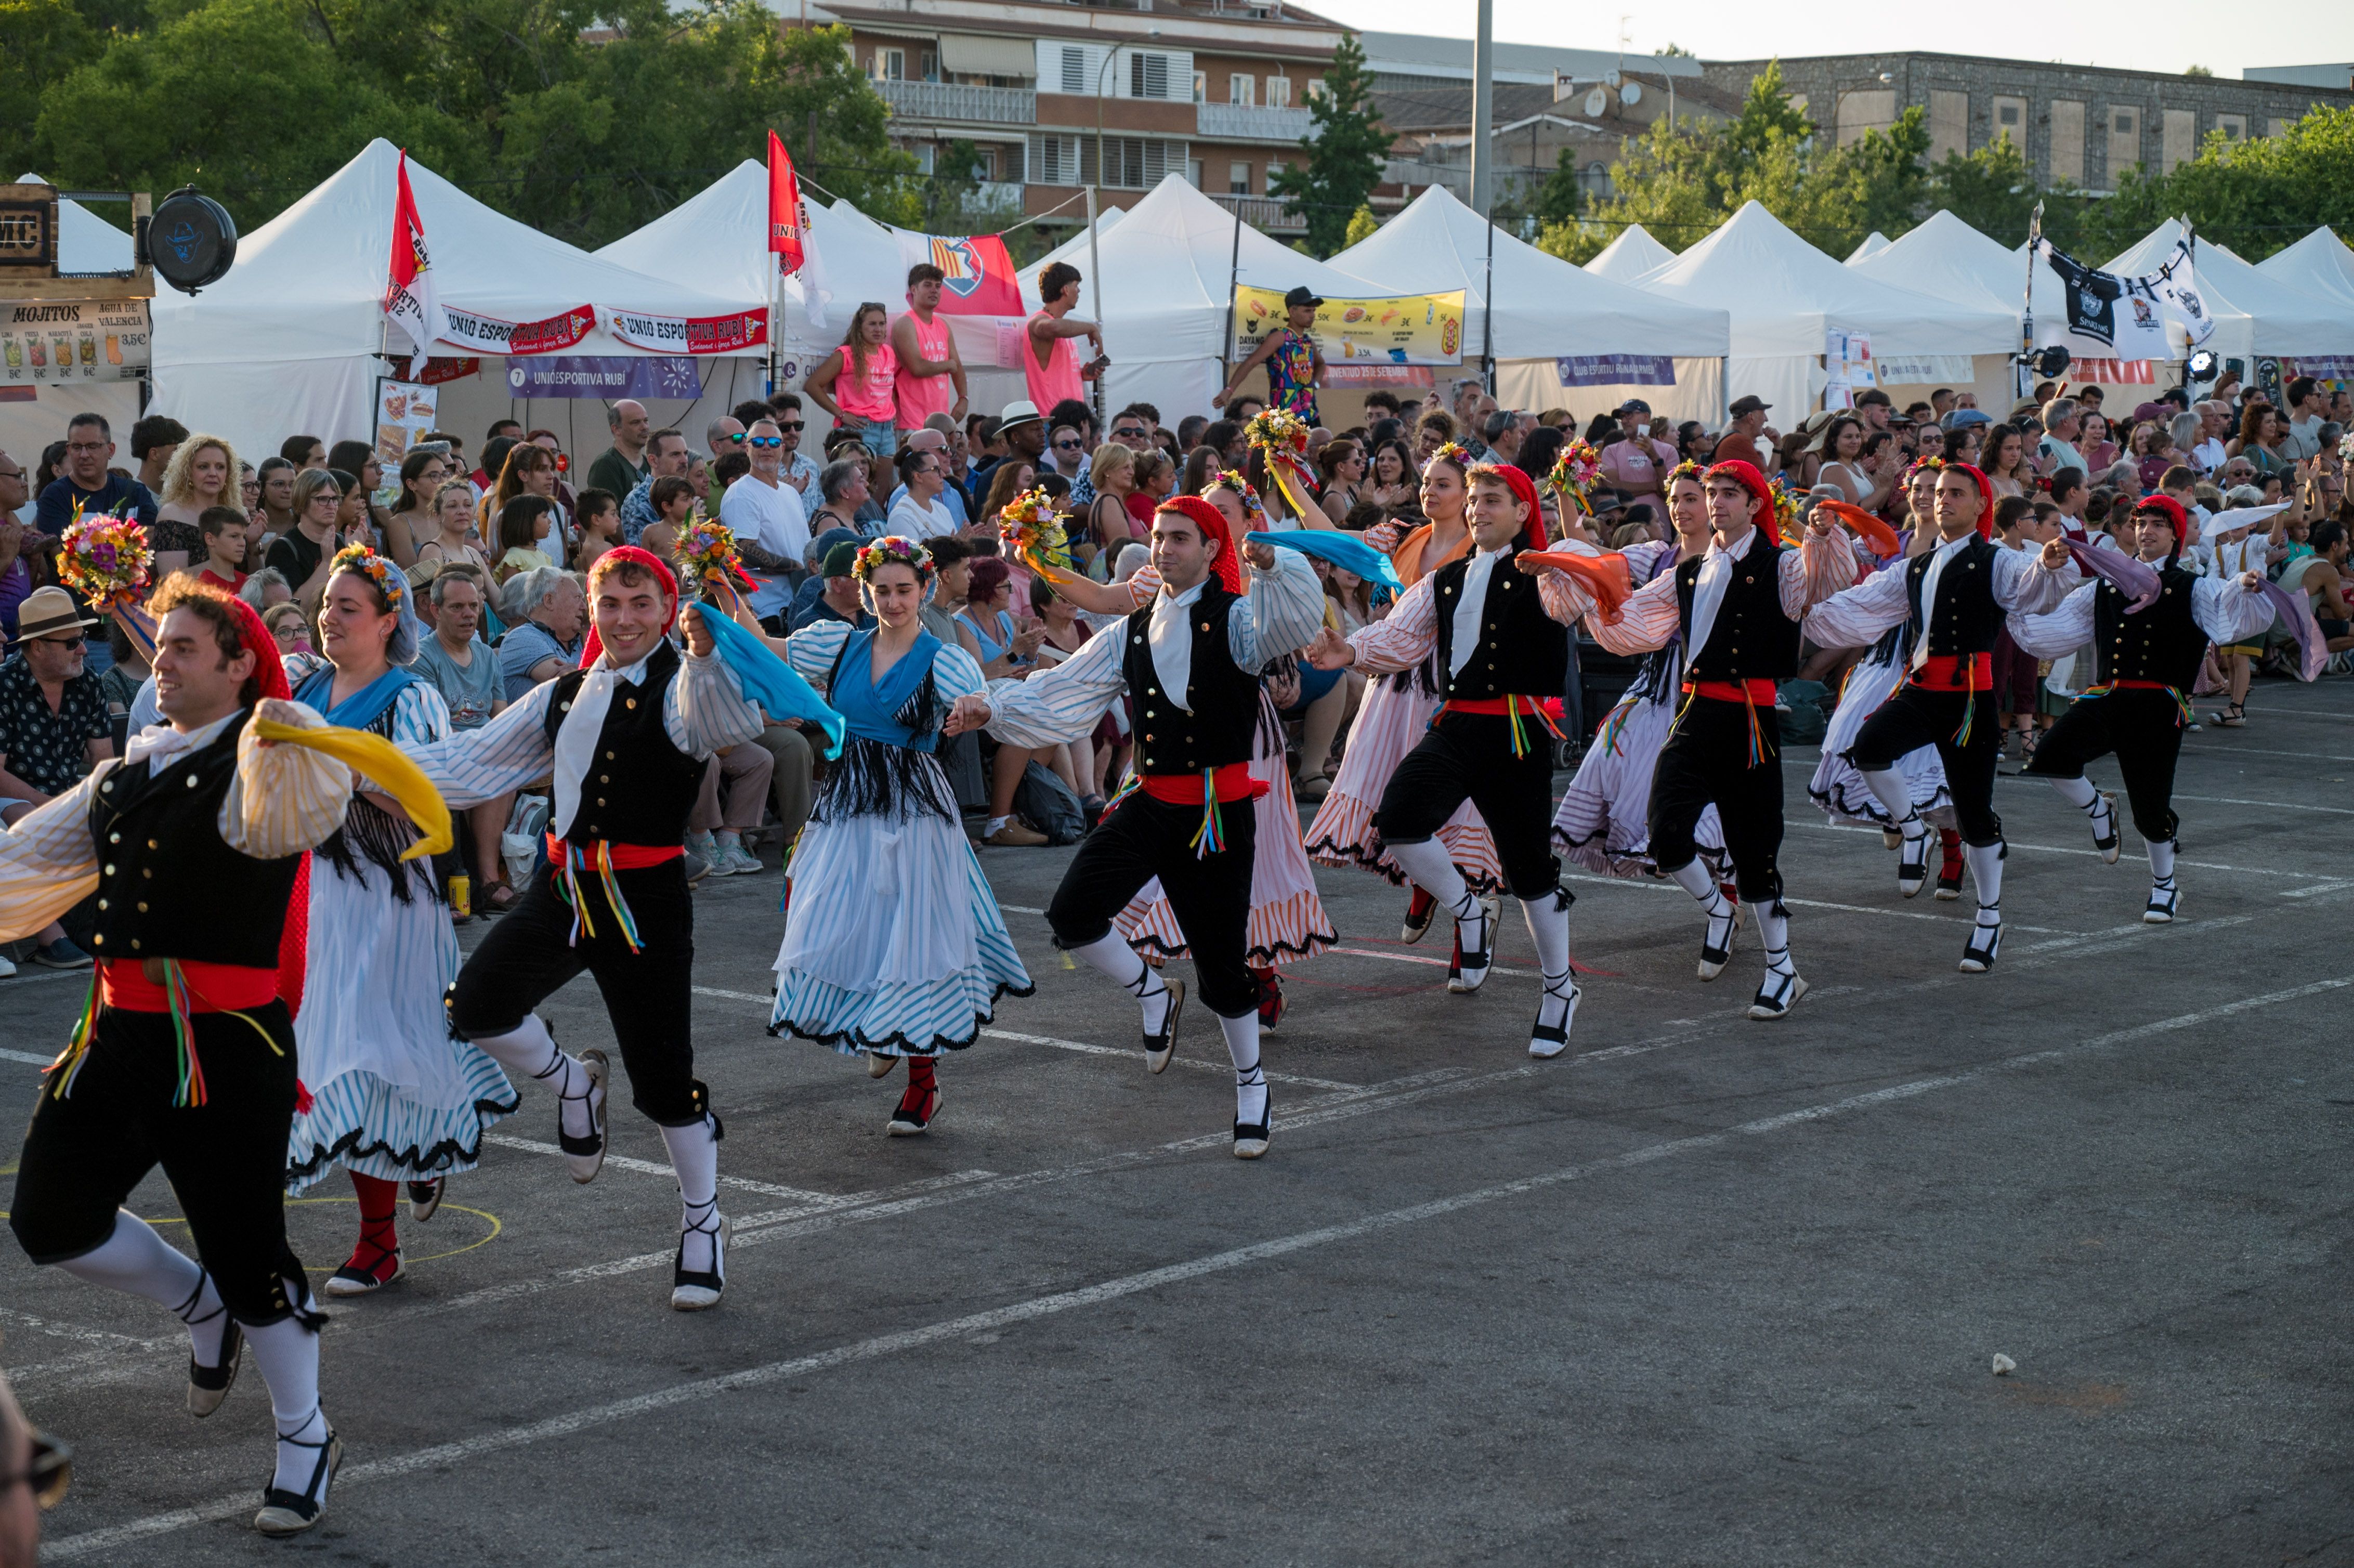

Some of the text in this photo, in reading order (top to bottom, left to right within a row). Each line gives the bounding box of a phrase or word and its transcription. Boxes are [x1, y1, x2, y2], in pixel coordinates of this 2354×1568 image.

[12, 305, 81, 322] MOJITOS
[99, 304, 137, 313] AGUA DE
[98, 317, 142, 326] VALENCIA
[2080, 316, 2109, 334] SPARTANS
[448, 313, 476, 337] UNIÓ
[479, 322, 540, 341] ESPORTIVA
[542, 315, 569, 337] RUBÍ
[626, 318, 654, 337] UNIÓ
[657, 322, 715, 341] ESPORTIVA
[717, 315, 743, 338] RUBÍ
[122, 333, 146, 346] 3,5€
[1239, 336, 1265, 345] DAYANG
[512, 343, 539, 351] Endavant
[690, 341, 714, 350] Endavant
[9, 369, 21, 379] 5€
[34, 368, 46, 378] 5€
[60, 367, 71, 377] 5€
[84, 367, 95, 376] 6€
[1377, 366, 1408, 377] SETEMBRE
[515, 369, 625, 385] 7 UNIÓ ESPORTIVA RUBÍ
